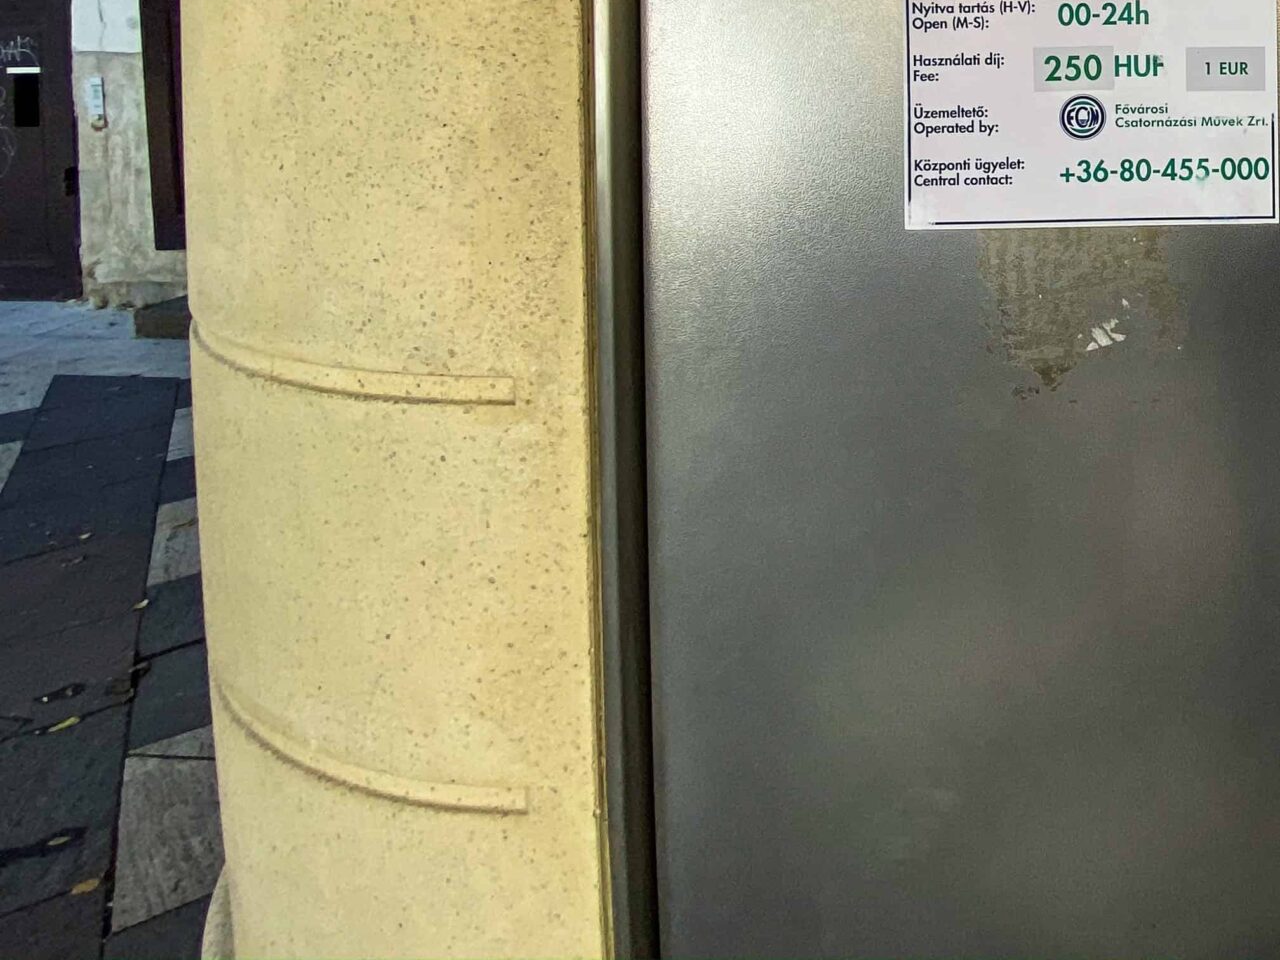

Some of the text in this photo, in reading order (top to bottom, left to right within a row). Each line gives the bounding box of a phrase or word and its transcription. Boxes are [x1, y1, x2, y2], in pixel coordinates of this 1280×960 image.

[912, 0, 1035, 18] Nyitva tartás (H-V):
[1058, 0, 1149, 26] 00-24h
[912, 17, 989, 30] Open (M-S):
[914, 52, 1004, 69] Használati díj:
[1045, 55, 1164, 81] 250 HUF
[1206, 62, 1248, 75] 1 EUR
[914, 70, 939, 81] Fee:
[914, 106, 988, 119] Üzemeltető:
[1116, 103, 1168, 114] Fővárosi
[914, 122, 998, 135] Operated by:
[1115, 117, 1196, 127] Csatornázási
[1201, 117, 1242, 126] Művek
[915, 158, 1024, 173] Központi ügyelet:
[1060, 157, 1269, 182] +36-80-455-000
[914, 174, 1012, 186] Central contact:
